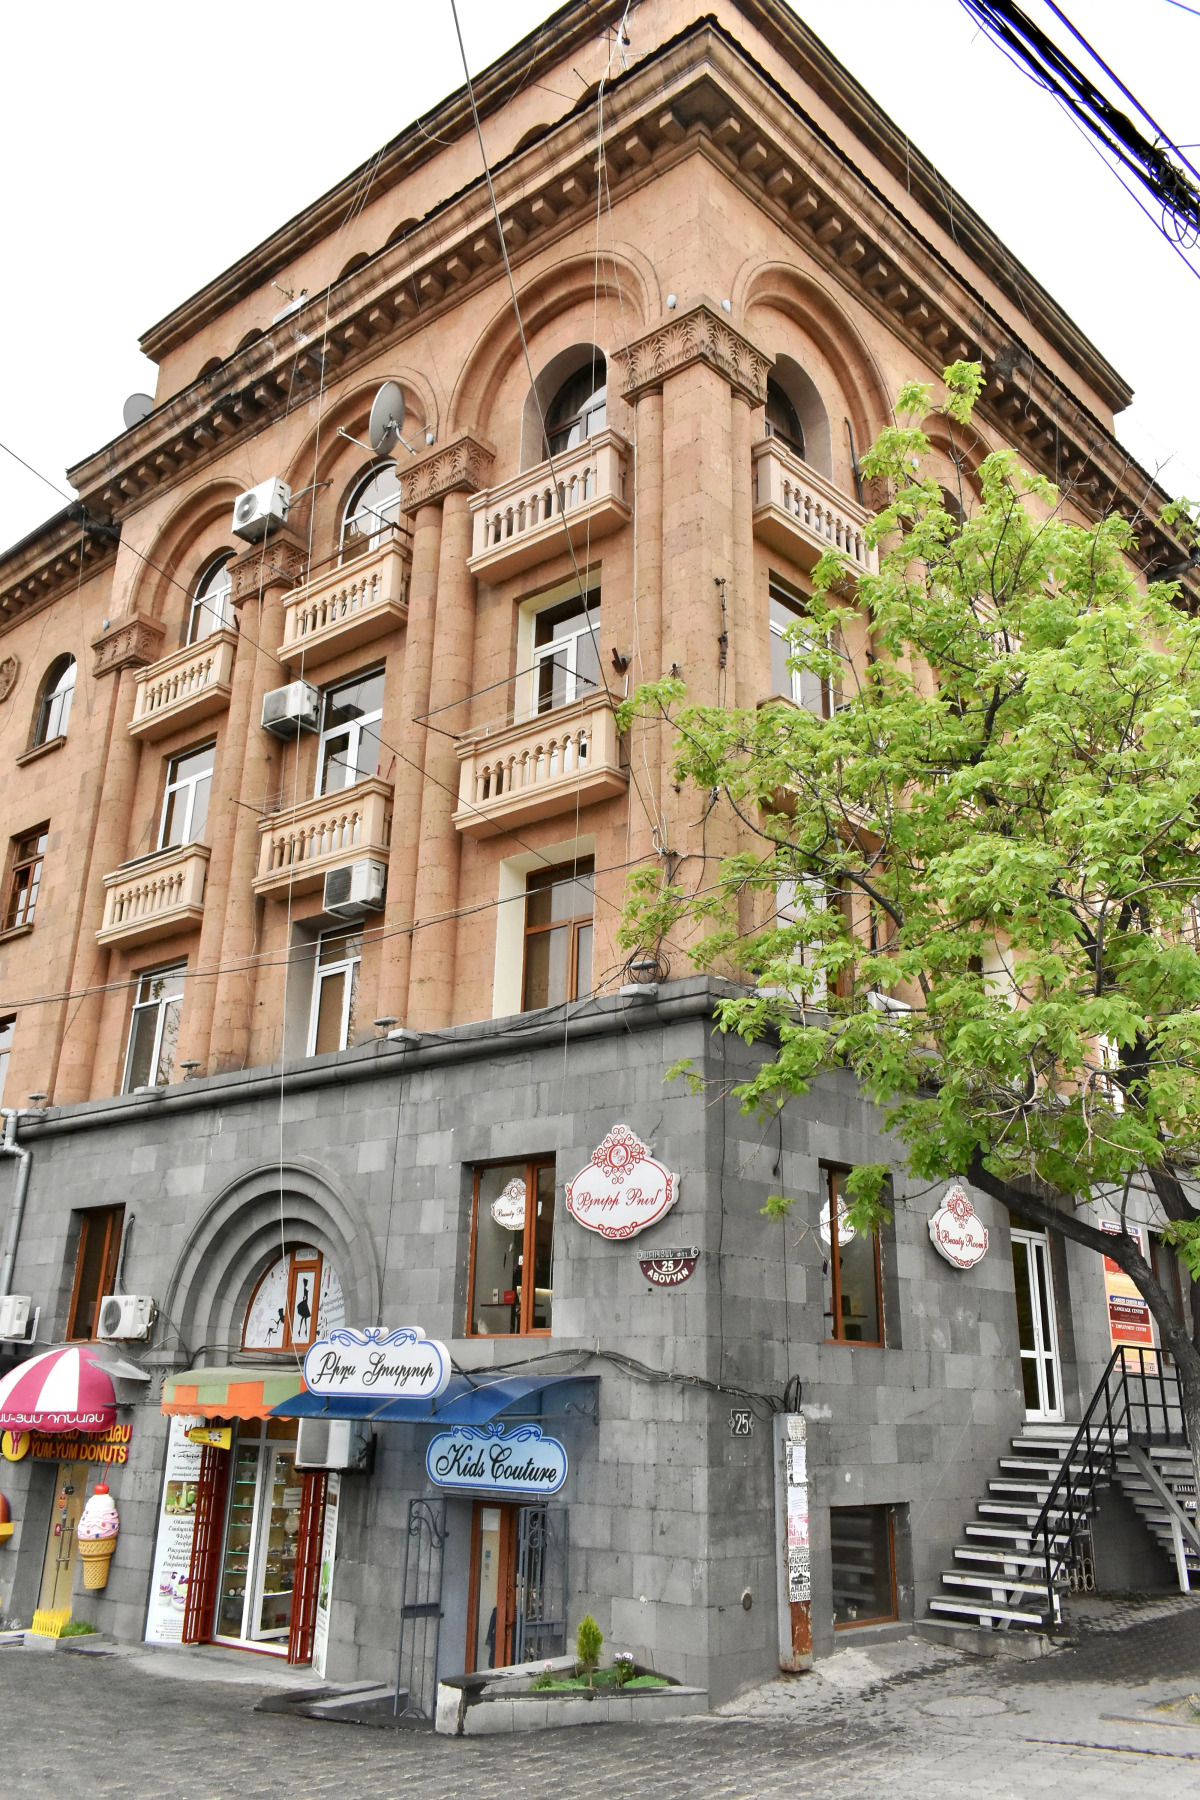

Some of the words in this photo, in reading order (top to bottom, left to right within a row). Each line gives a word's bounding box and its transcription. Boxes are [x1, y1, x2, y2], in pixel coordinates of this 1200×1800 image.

[941, 1229, 965, 1251] Beauty
[965, 1233, 984, 1249] Room
[647, 1267, 690, 1284] ABOVYAN
[661, 1260, 674, 1272] 25
[735, 1413, 749, 1434] 25
[31, 1441, 79, 1459] YUM-YUM
[80, 1443, 128, 1464] DONUTS
[435, 1443, 486, 1478] Kids
[489, 1443, 558, 1483] Couture
